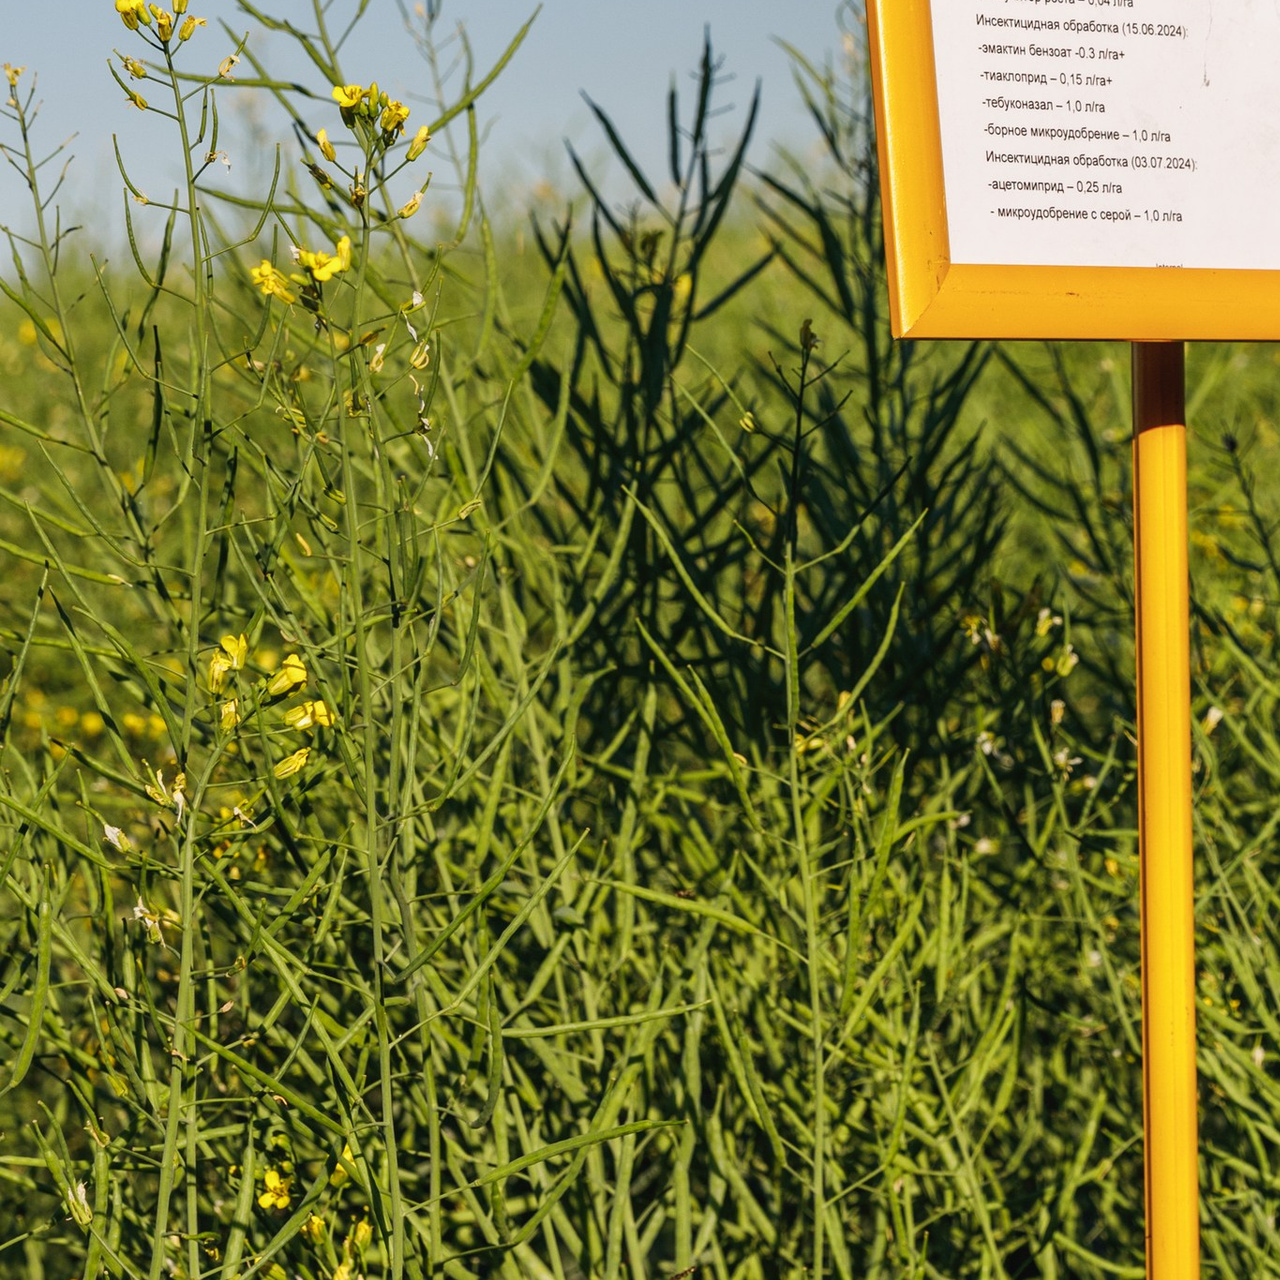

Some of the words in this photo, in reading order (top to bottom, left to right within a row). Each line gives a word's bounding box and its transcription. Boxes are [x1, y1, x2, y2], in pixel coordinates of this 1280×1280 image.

[975, 13, 1061, 32] Инсектицидная
[1062, 18, 1120, 35] обработка
[977, 43, 1027, 56] -эмактин
[1028, 43, 1073, 58] бензоат
[1097, 47, 1126, 61] л/га+
[979, 70, 1048, 86] -тиаклоприд
[1059, 72, 1083, 87] 0,15
[1085, 73, 1113, 87] л/га+
[981, 95, 1054, 112] -тебуконазал
[1065, 99, 1083, 114] 1,0
[1084, 100, 1106, 114] л/га
[983, 122, 1028, 139] -борное
[1030, 126, 1120, 143] микроудобрение
[1132, 129, 1149, 143] 1,0
[1150, 130, 1172, 143] л/га
[985, 150, 1071, 167] Инсектицидная
[1072, 153, 1129, 169] обработка
[987, 179, 1065, 194] -ацетомиприд
[1076, 180, 1100, 195] 0,25
[1101, 181, 1123, 194] л/га
[997, 205, 1089, 222] микроудобрение
[1090, 210, 1098, 220] с
[1099, 208, 1132, 224] серой
[1143, 209, 1160, 223] 1,0
[1162, 209, 1183, 223] л/га
